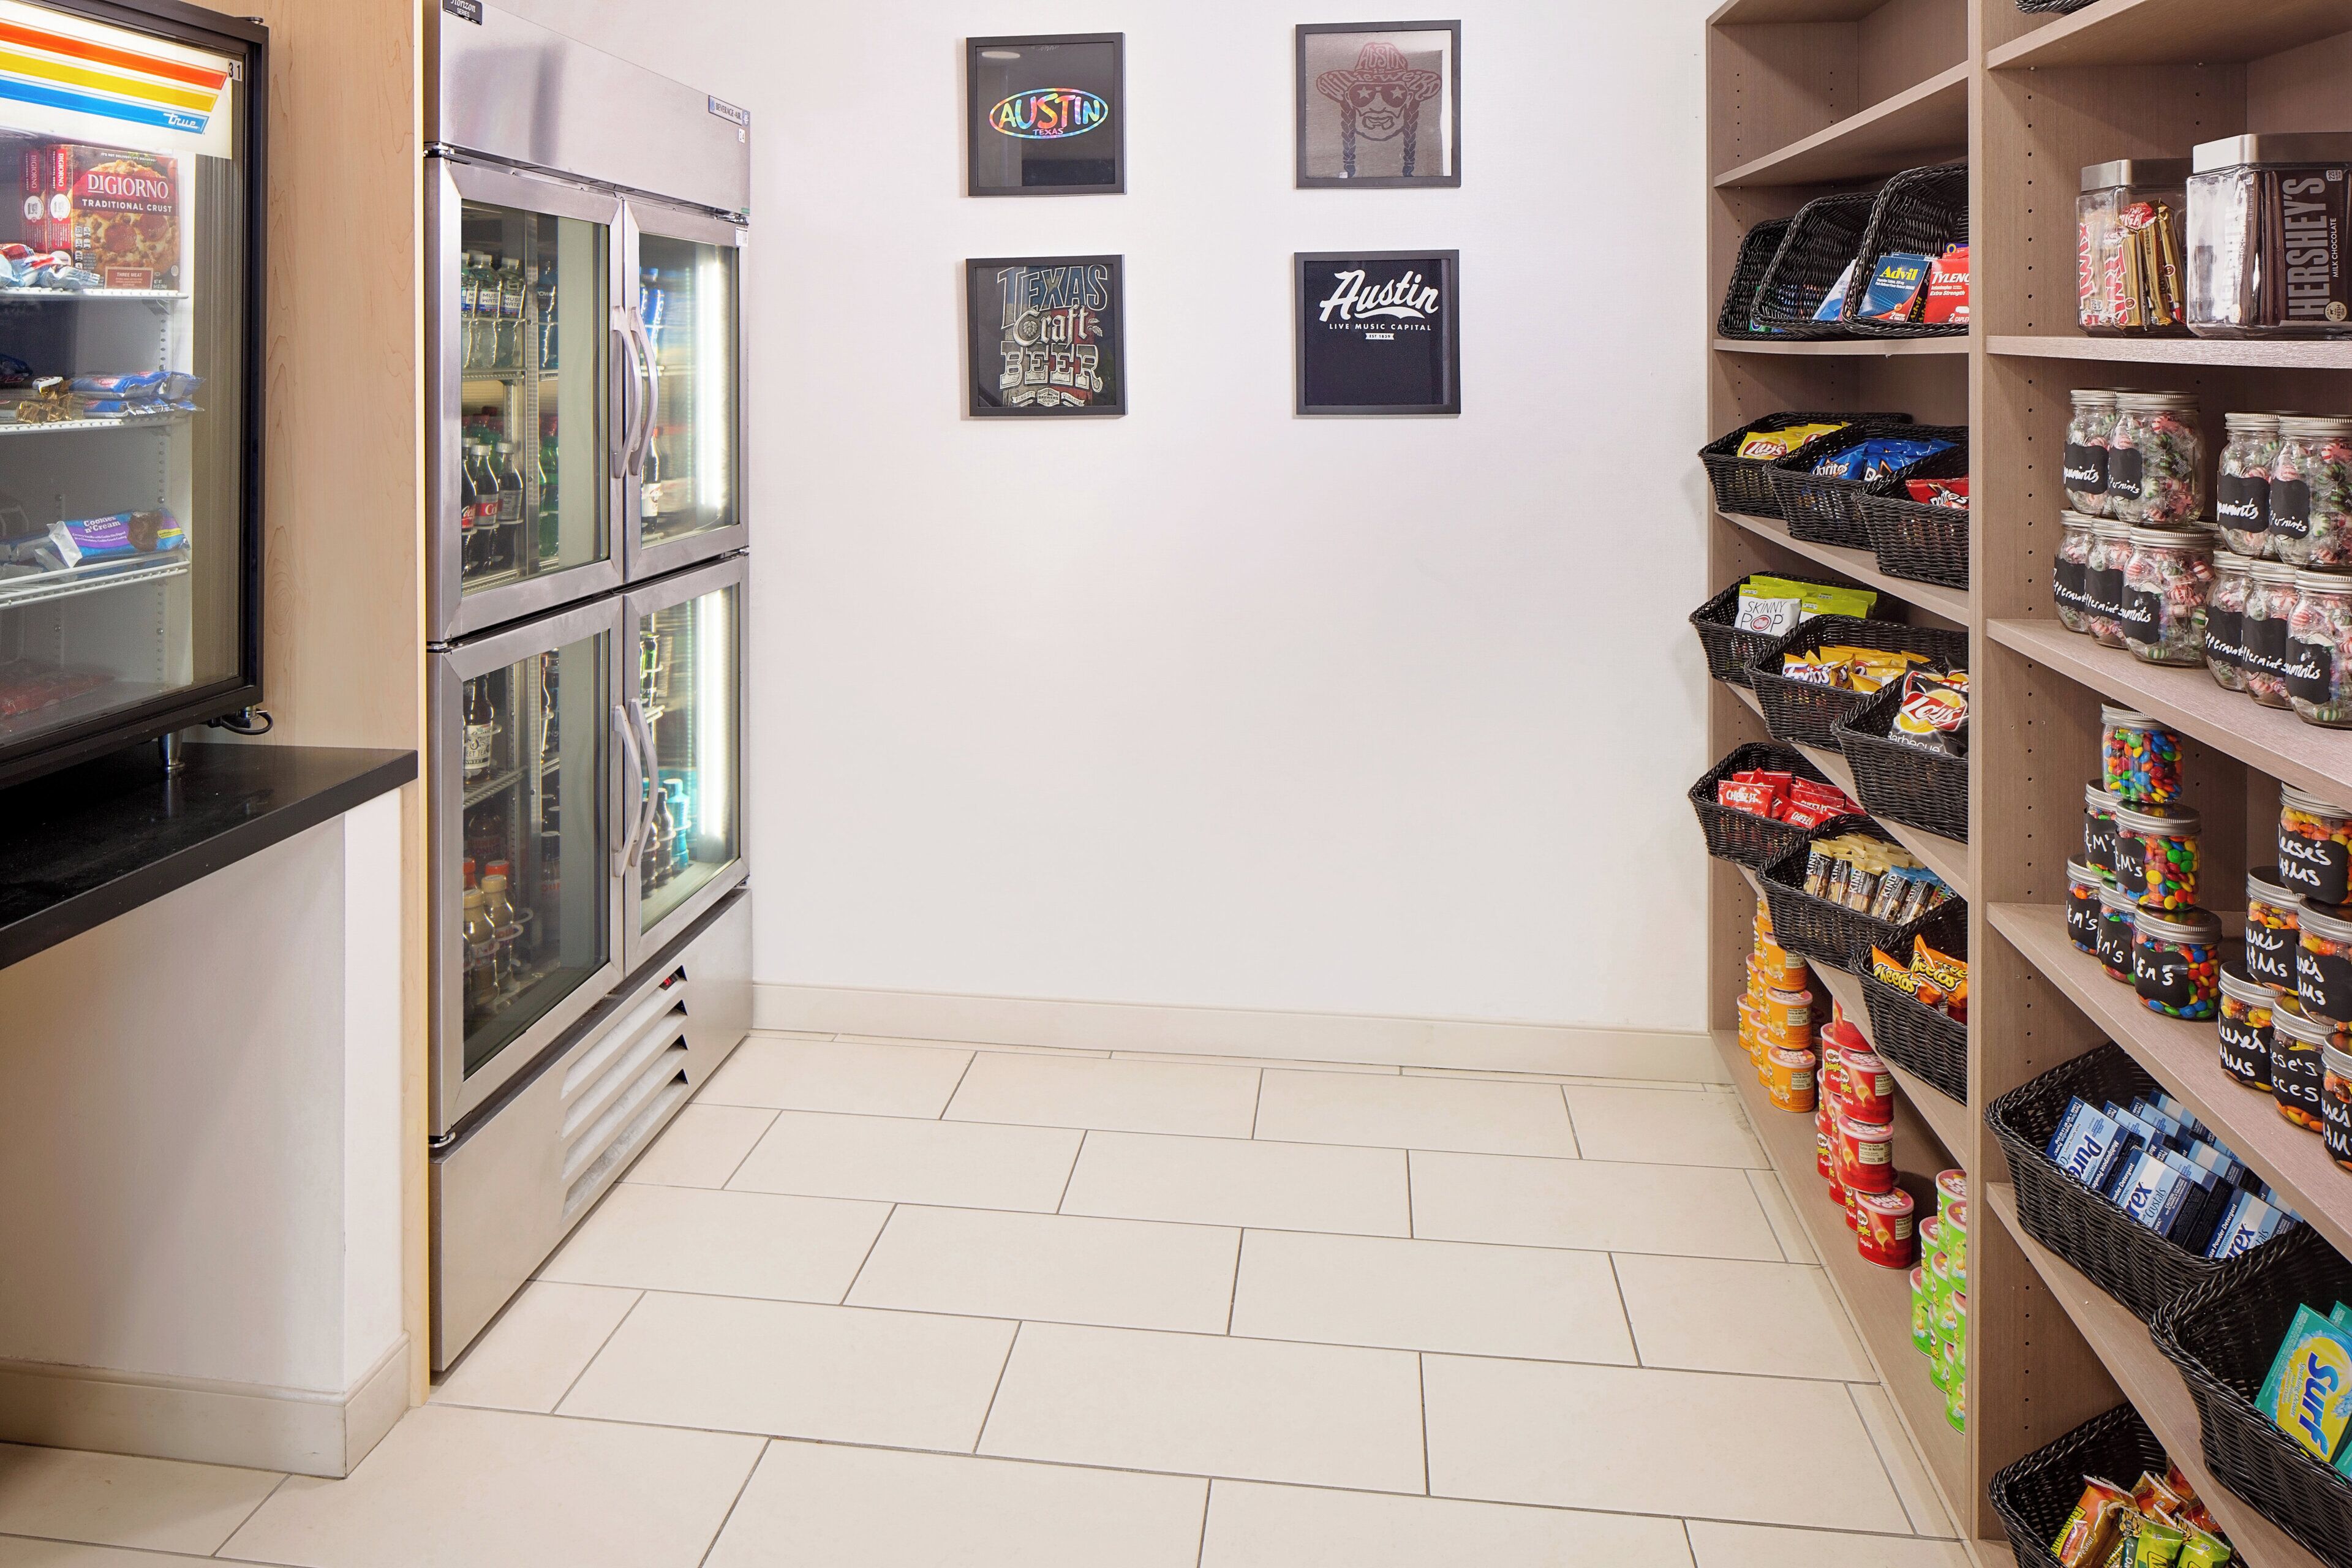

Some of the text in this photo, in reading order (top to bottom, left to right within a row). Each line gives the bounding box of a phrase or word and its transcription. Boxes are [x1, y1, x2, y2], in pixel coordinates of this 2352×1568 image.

[457, 7, 470, 17] SERIES
[228, 62, 241, 80] 31
[998, 93, 1099, 129] AUSTIN
[88, 174, 169, 199] DIGIORNO
[82, 198, 172, 213] TRADITIONAL CRUST
[2282, 178, 2330, 316] HERSHEY'S
[1879, 266, 1919, 281] Advil
[1931, 271, 1969, 284] TYLENO
[997, 265, 1107, 330] TEXAS
[1319, 270, 1439, 322] Austin
[1013, 304, 1088, 349] Craft
[1948, 313, 1954, 322] 2
[1000, 341, 1103, 393] BEER
[1746, 442, 1785, 456] Lay's
[1812, 462, 1850, 477] Doritos
[1741, 613, 1783, 633] POP
[1901, 695, 1961, 727] Lay's
[1806, 851, 1817, 875] KIND
[1850, 869, 1861, 893] KIND
[1882, 873, 1898, 897] KIND
[2067, 905, 2098, 930] &M's
[1874, 964, 1919, 993] Cheetos
[1825, 1062, 1841, 1072] Pringle
[2271, 1049, 2318, 1077] ese's
[2272, 1073, 2319, 1102] eces
[2091, 1140, 2119, 1189] Multipurpose Powder
[2119, 1163, 2135, 1186] Detergent
[2119, 1189, 2130, 1205] FESSIONAL
[2126, 1182, 2152, 1218] rex
[2145, 1187, 2166, 1218] Crystals
[2212, 1204, 2237, 1248] Powder Detergent
[2227, 1223, 2255, 1257] rex
[2290, 1392, 2300, 1417] Ocean
[2299, 1352, 2339, 1456] Surf
[2053, 1509, 2082, 1553] ATURE VALLEY
[2079, 1536, 2094, 1558] Peanut
